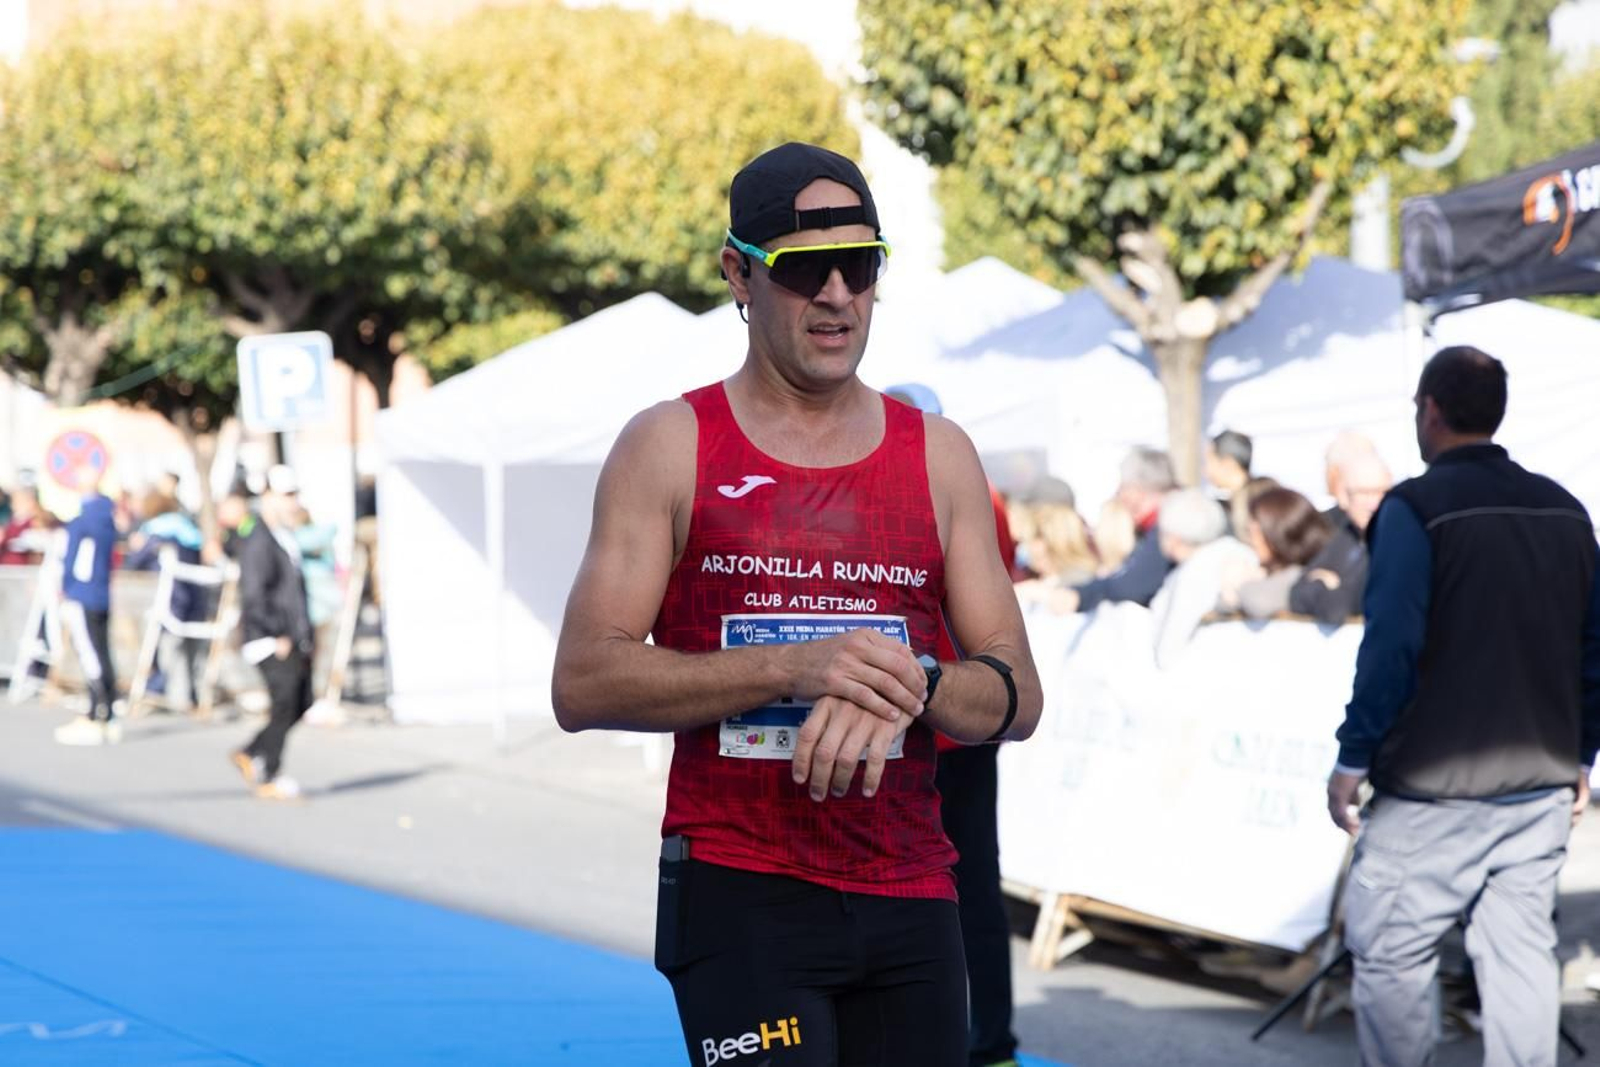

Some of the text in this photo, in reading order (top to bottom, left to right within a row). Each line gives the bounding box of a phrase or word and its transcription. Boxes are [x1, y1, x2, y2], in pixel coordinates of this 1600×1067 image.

[256, 345, 316, 418] P
[701, 555, 928, 587] ARJONILLA RUNNING
[744, 592, 877, 612] CLUB ATLETISMO
[702, 1016, 801, 1067] BeeHi
